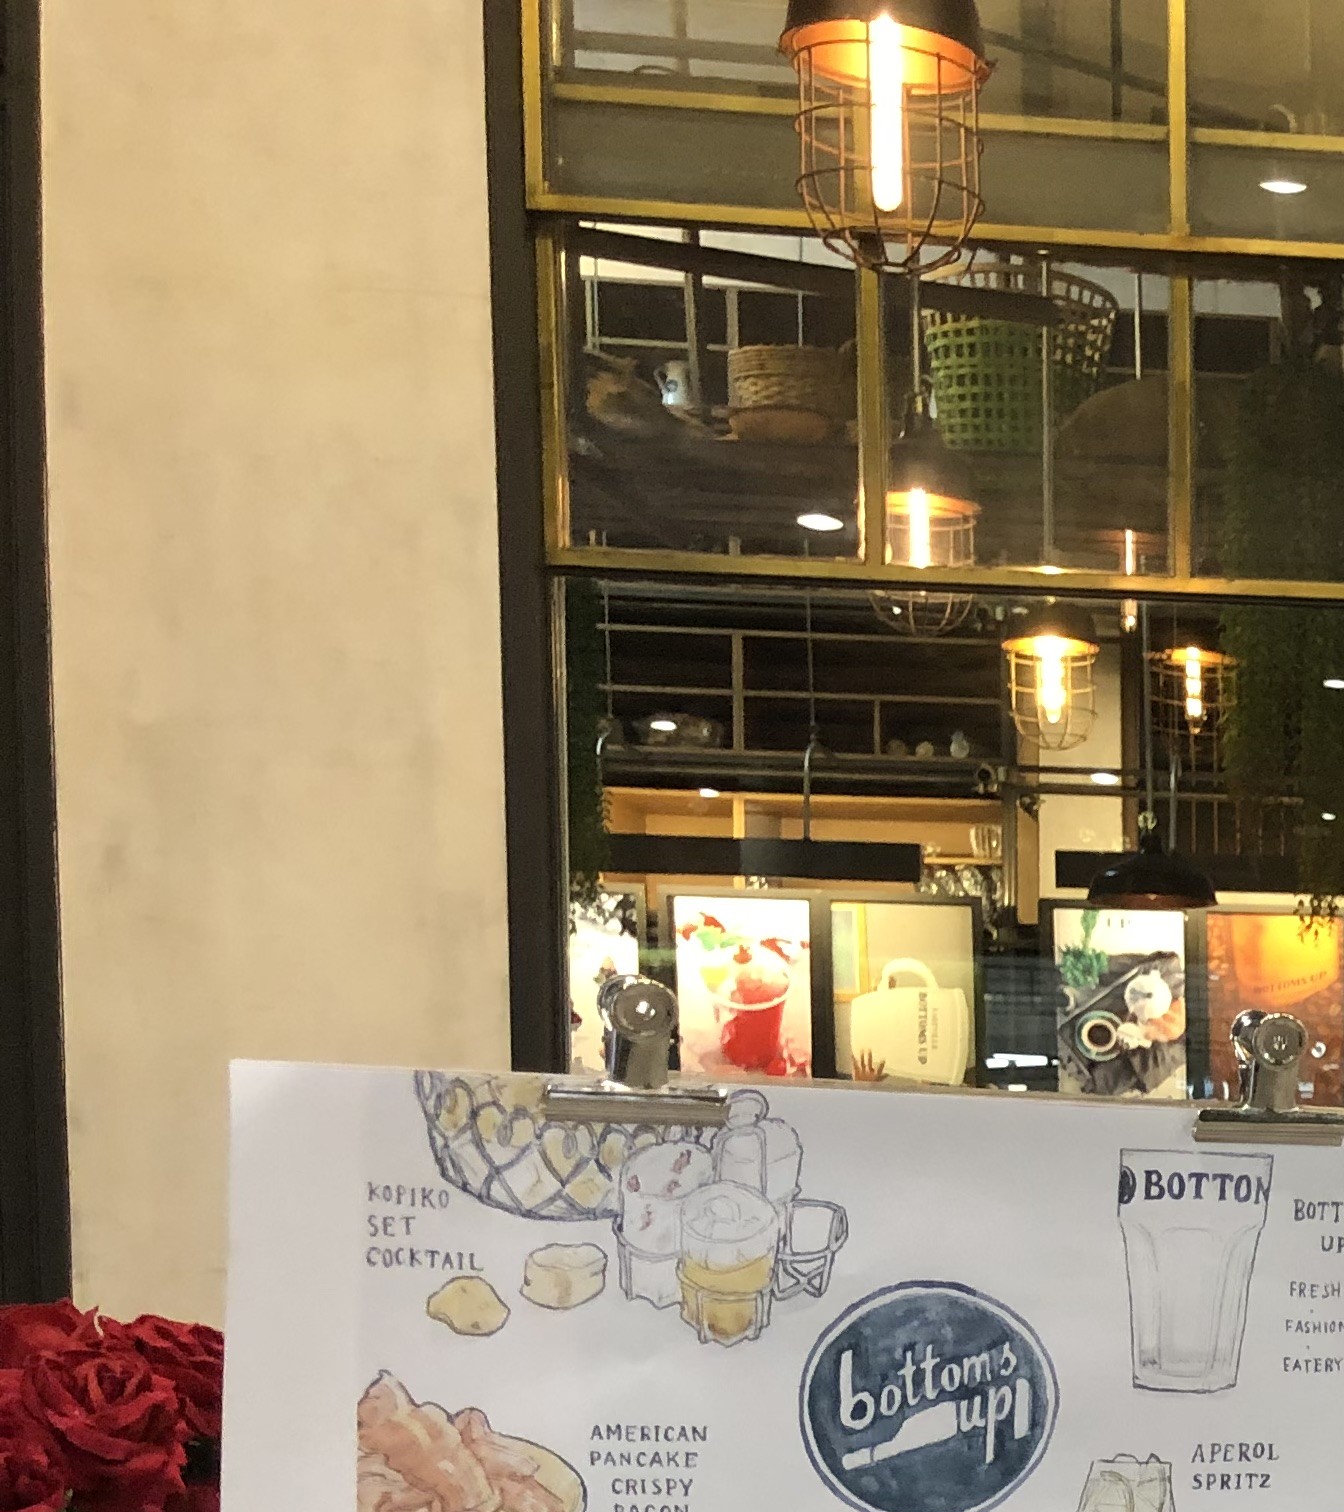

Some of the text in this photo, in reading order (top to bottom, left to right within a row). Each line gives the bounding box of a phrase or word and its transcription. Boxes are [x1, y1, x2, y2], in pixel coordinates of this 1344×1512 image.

[367, 1181, 450, 1209] KOPIKO
[367, 1214, 414, 1237] SET
[366, 1247, 484, 1272] COCKTAIL
[1289, 1280, 1341, 1299] FRESH
[1283, 1356, 1344, 1374] EATERY
[840, 1342, 1017, 1431] bottoms
[590, 1424, 708, 1444] AMERICAN
[589, 1450, 699, 1469] PANCAKE
[1191, 1442, 1280, 1463] APEROL
[610, 1477, 694, 1498] CRISPY
[1192, 1473, 1271, 1490] SPRITZ
